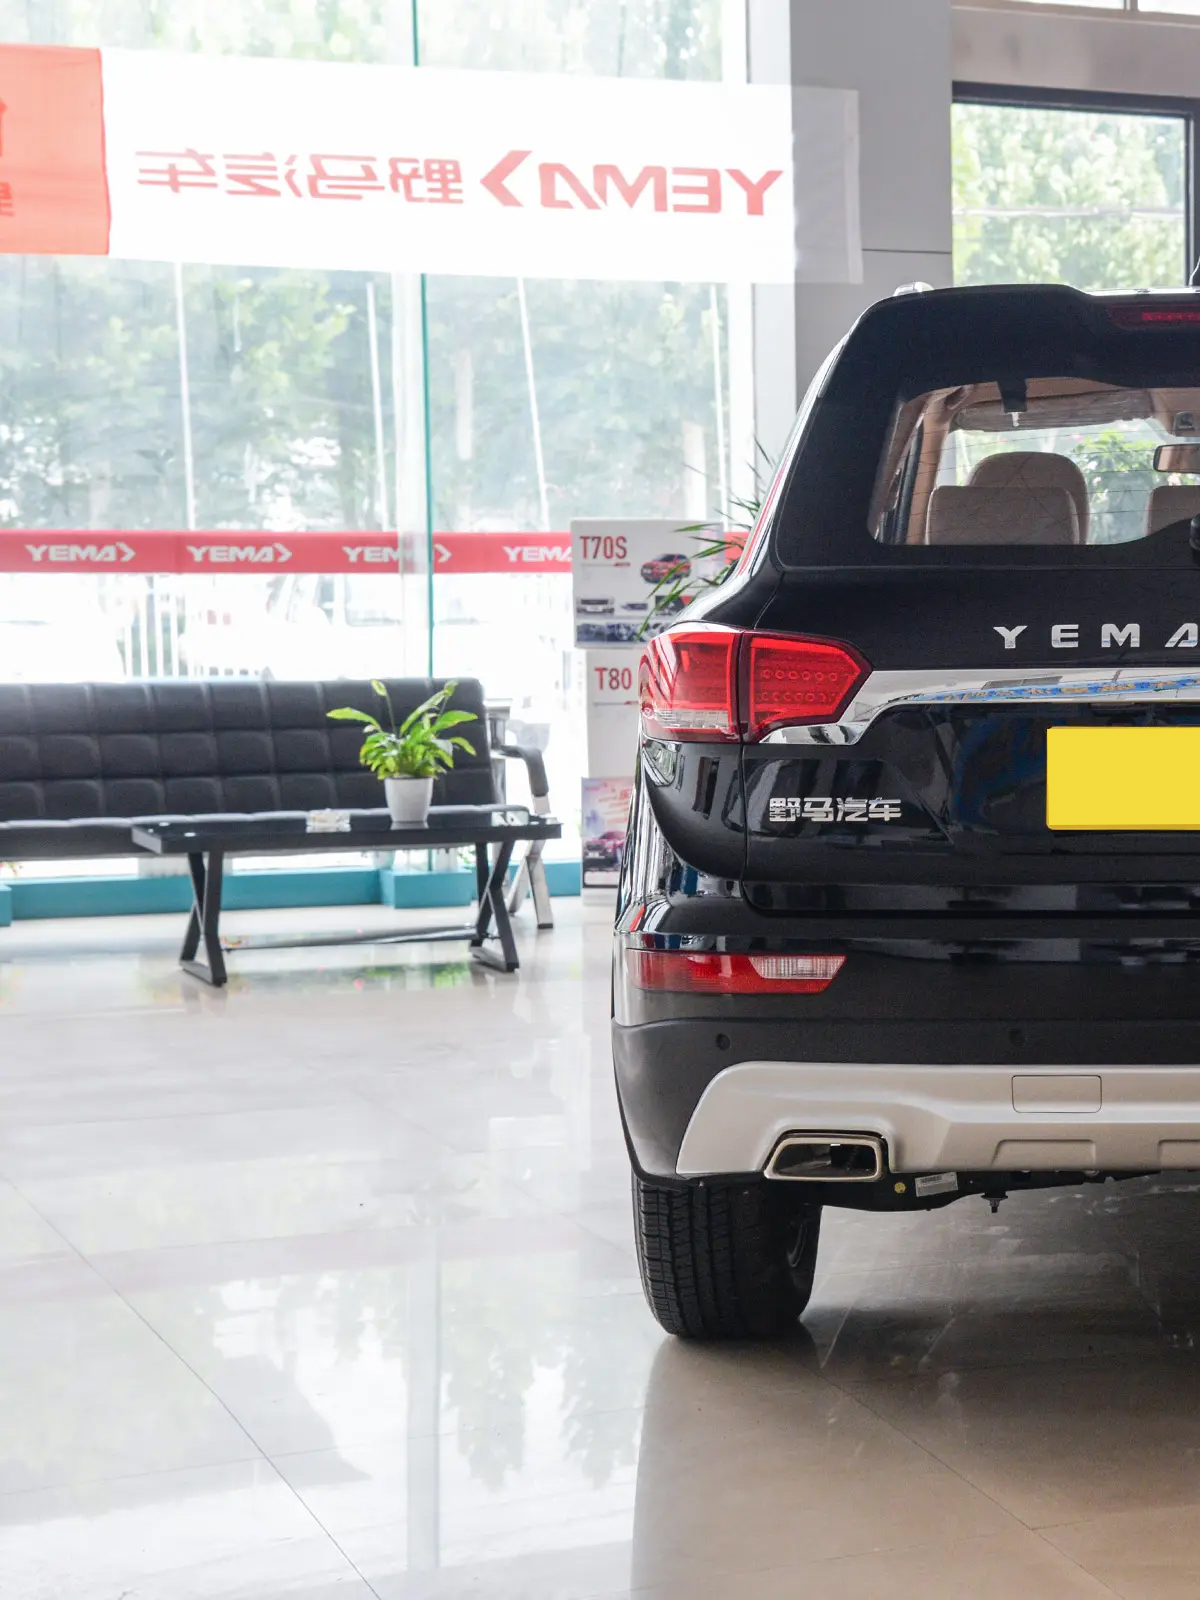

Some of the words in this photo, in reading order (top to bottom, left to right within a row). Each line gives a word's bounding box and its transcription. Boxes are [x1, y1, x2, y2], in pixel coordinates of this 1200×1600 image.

[24, 544, 118, 562] YEMA
[186, 545, 275, 563] YEMA
[579, 535, 628, 560] T70S
[594, 667, 632, 691] T80
[769, 797, 903, 822] 野马汽车
